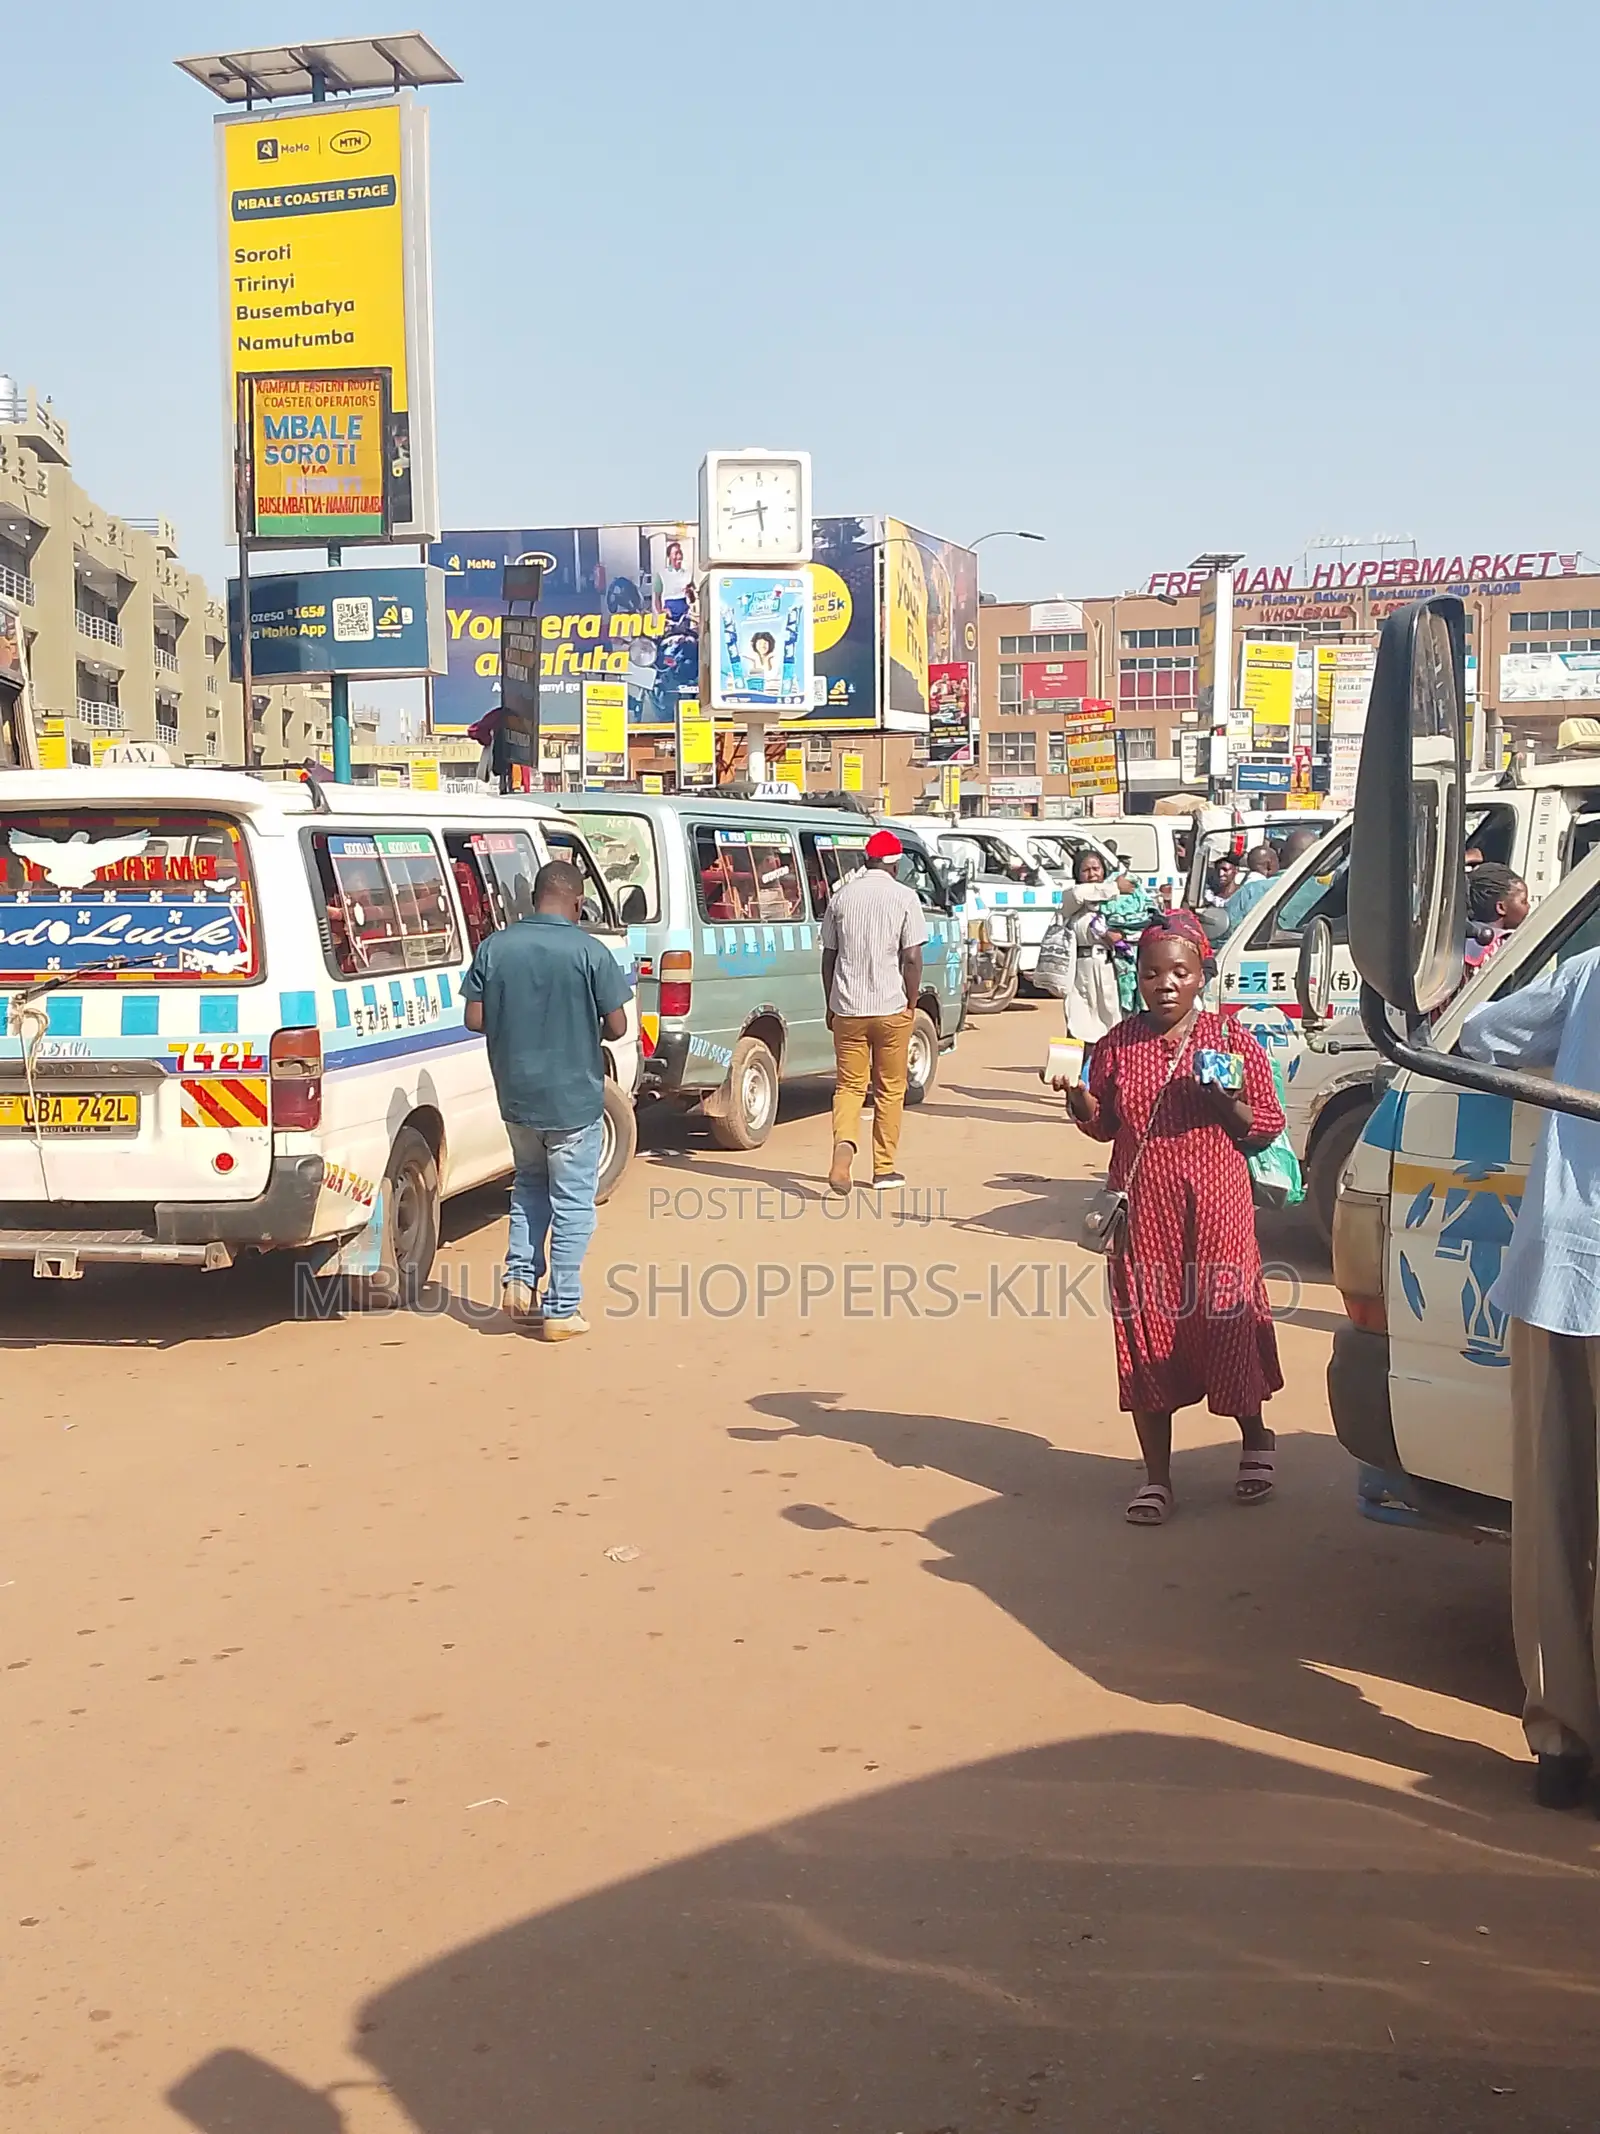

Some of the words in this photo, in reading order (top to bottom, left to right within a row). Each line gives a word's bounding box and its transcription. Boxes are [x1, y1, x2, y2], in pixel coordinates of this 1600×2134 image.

[281, 143, 310, 153] MoMo
[339, 136, 362, 147] MTN
[237, 197, 283, 210] MBALE
[284, 190, 345, 206] COASTER
[347, 184, 389, 199] STAGE
[234, 243, 292, 264] Soroti
[234, 273, 295, 293] Tirinyi
[236, 298, 355, 321] Busembatya
[238, 330, 355, 351] Namutumba
[257, 380, 300, 394] KAMPALA
[303, 380, 345, 393] EASTERN
[347, 379, 380, 392] ROUTE
[263, 397, 312, 408] COASTER
[315, 395, 376, 407] OPERATORS
[264, 414, 363, 440] MBALE
[264, 443, 356, 465] SOROTI
[301, 465, 328, 474] VIA
[1150, 566, 1293, 596] FREMAN
[1311, 552, 1558, 590] HYPERMARKET
[827, 598, 846, 611] 5k
[251, 610, 284, 623] ozesa
[608, 612, 666, 636] mu
[262, 626, 298, 637] MoMo
[299, 623, 327, 638] App
[110, 747, 156, 763] TAXI
[761, 783, 789, 796] TAXI
[67, 914, 234, 945] Luck
[168, 1042, 263, 1071] 742L
[24, 1098, 62, 1123] UBA
[77, 1098, 129, 1123] 742L
